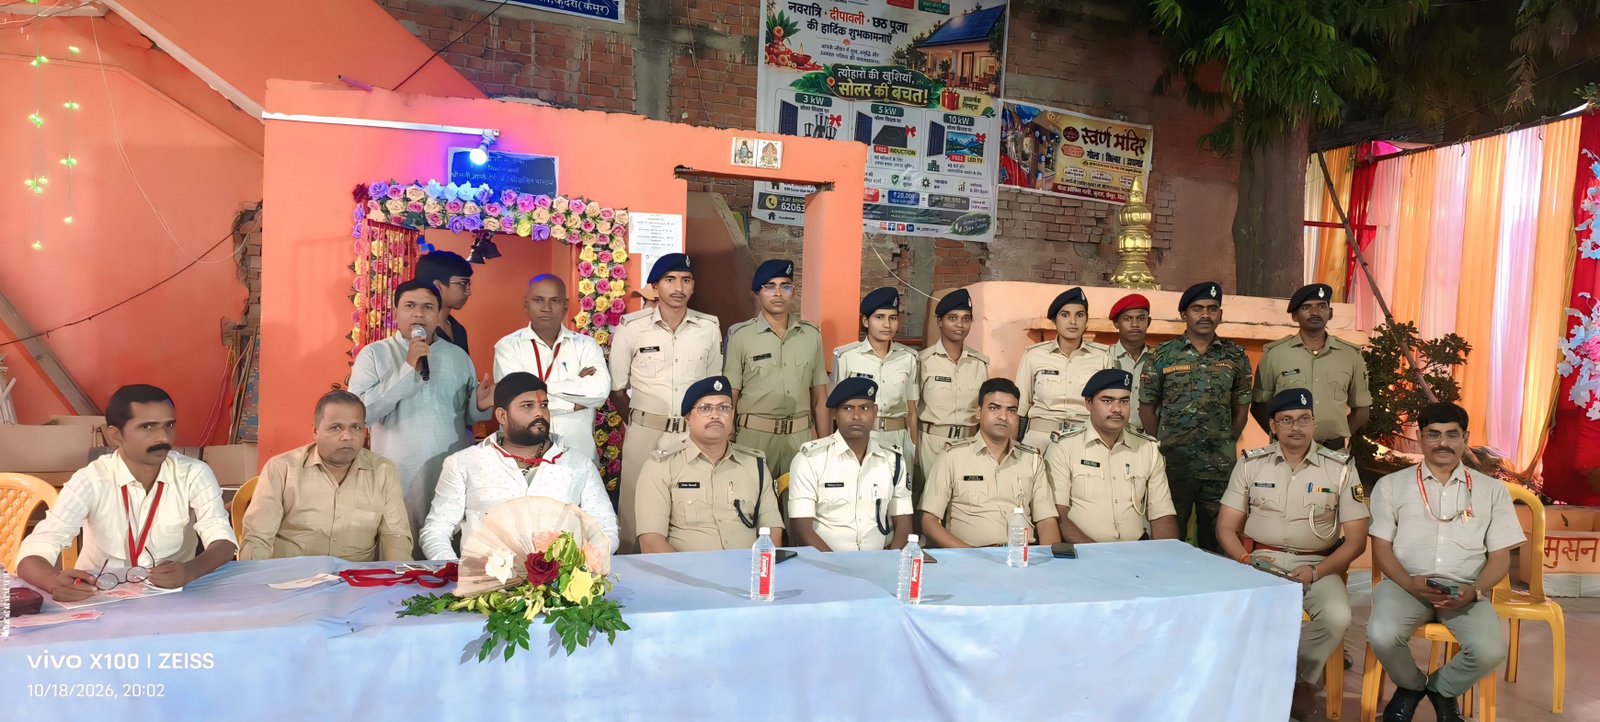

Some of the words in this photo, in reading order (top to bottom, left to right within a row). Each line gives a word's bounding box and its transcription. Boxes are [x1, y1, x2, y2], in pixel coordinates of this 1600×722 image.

[788, 1, 822, 18] नवरात्रि
[830, 7, 865, 26] दीपावली
[872, 16, 887, 28] छठ
[890, 20, 908, 34] पूजा
[807, 19, 818, 31] की
[821, 22, 846, 36] हार्दिक
[838, 67, 866, 80] त्योहारों
[868, 70, 879, 80] की
[838, 79, 872, 97] सोलर
[874, 84, 889, 99] की
[892, 86, 928, 103] बचत!
[811, 96, 824, 105] kW
[885, 106, 897, 115] kW
[948, 115, 957, 123] 10
[958, 117, 970, 125] kW
[1081, 127, 1112, 148] स्वर्ण
[1114, 128, 1147, 156] मंदिर
